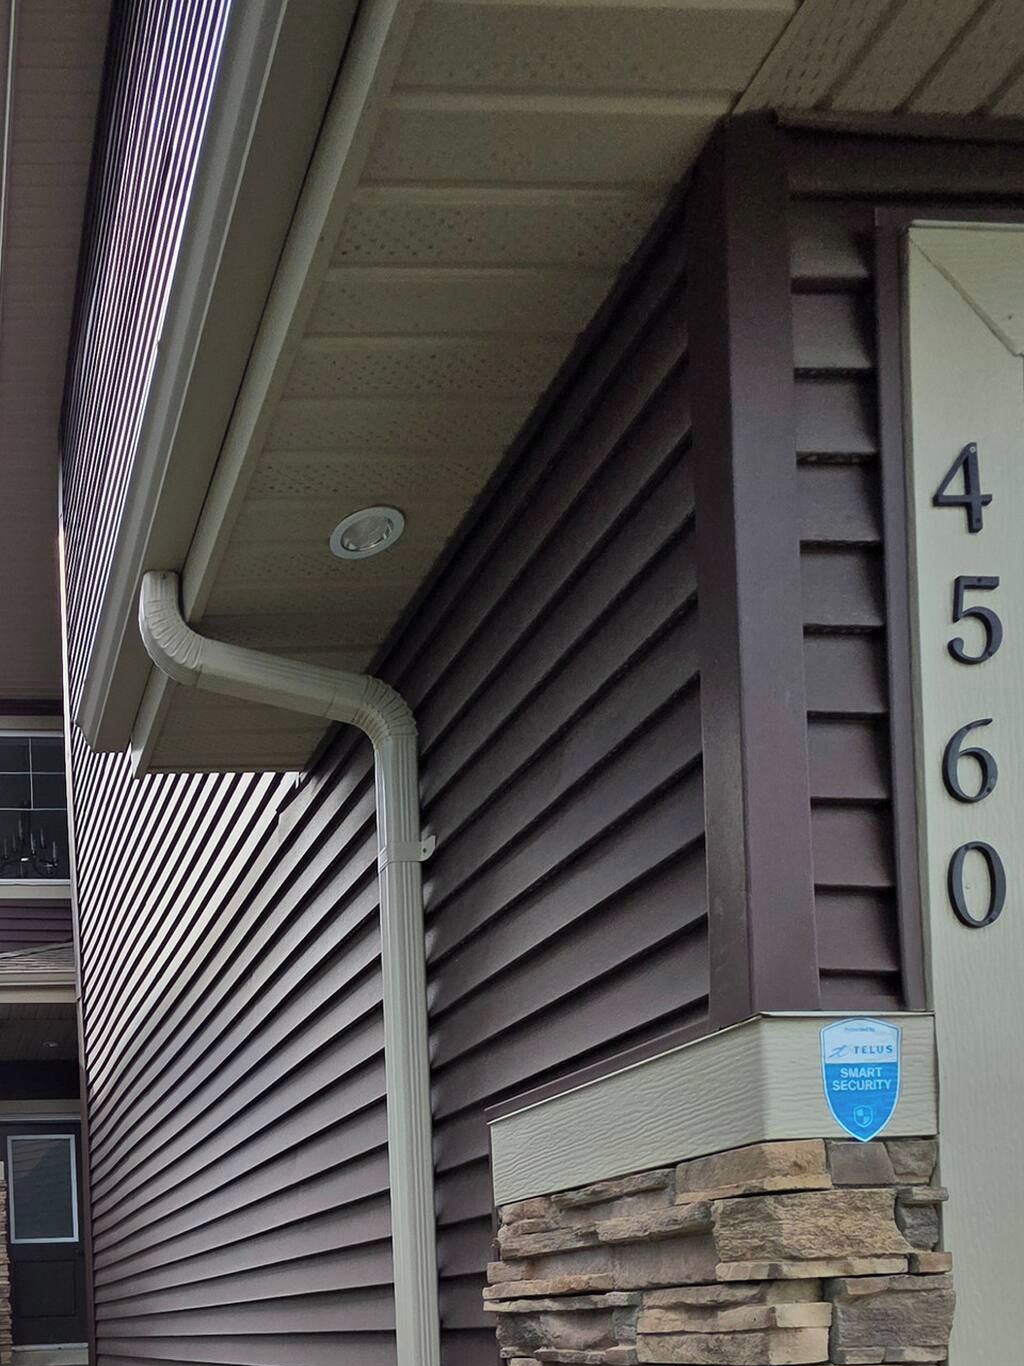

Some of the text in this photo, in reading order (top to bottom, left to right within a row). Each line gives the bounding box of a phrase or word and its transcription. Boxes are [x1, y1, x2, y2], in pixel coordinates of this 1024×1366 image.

[933, 442, 1007, 929] 4560
[853, 1044, 894, 1055] TELUS
[840, 1067, 883, 1078] SMART
[832, 1079, 892, 1092] SECURITY
